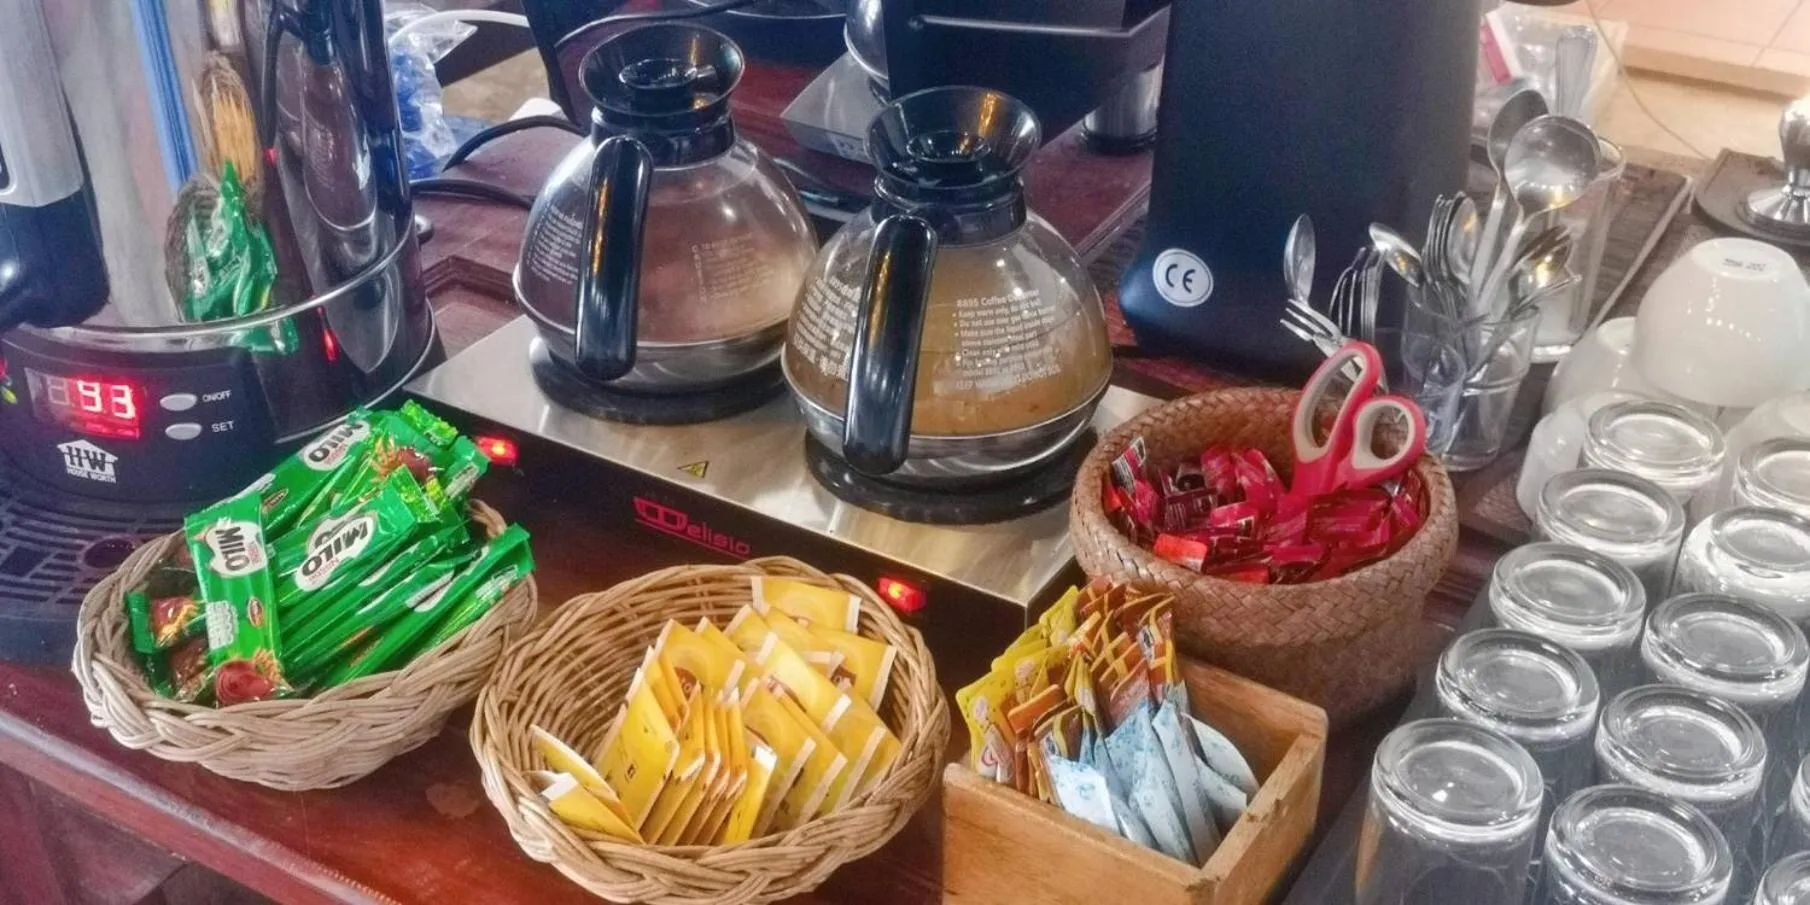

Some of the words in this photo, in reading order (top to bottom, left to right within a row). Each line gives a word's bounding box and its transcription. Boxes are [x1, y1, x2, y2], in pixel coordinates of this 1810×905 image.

[1165, 264, 1196, 294] CE
[77, 379, 136, 419] 93
[211, 420, 234, 433] SET
[215, 526, 250, 572] MILO
[302, 521, 369, 577] MILO
